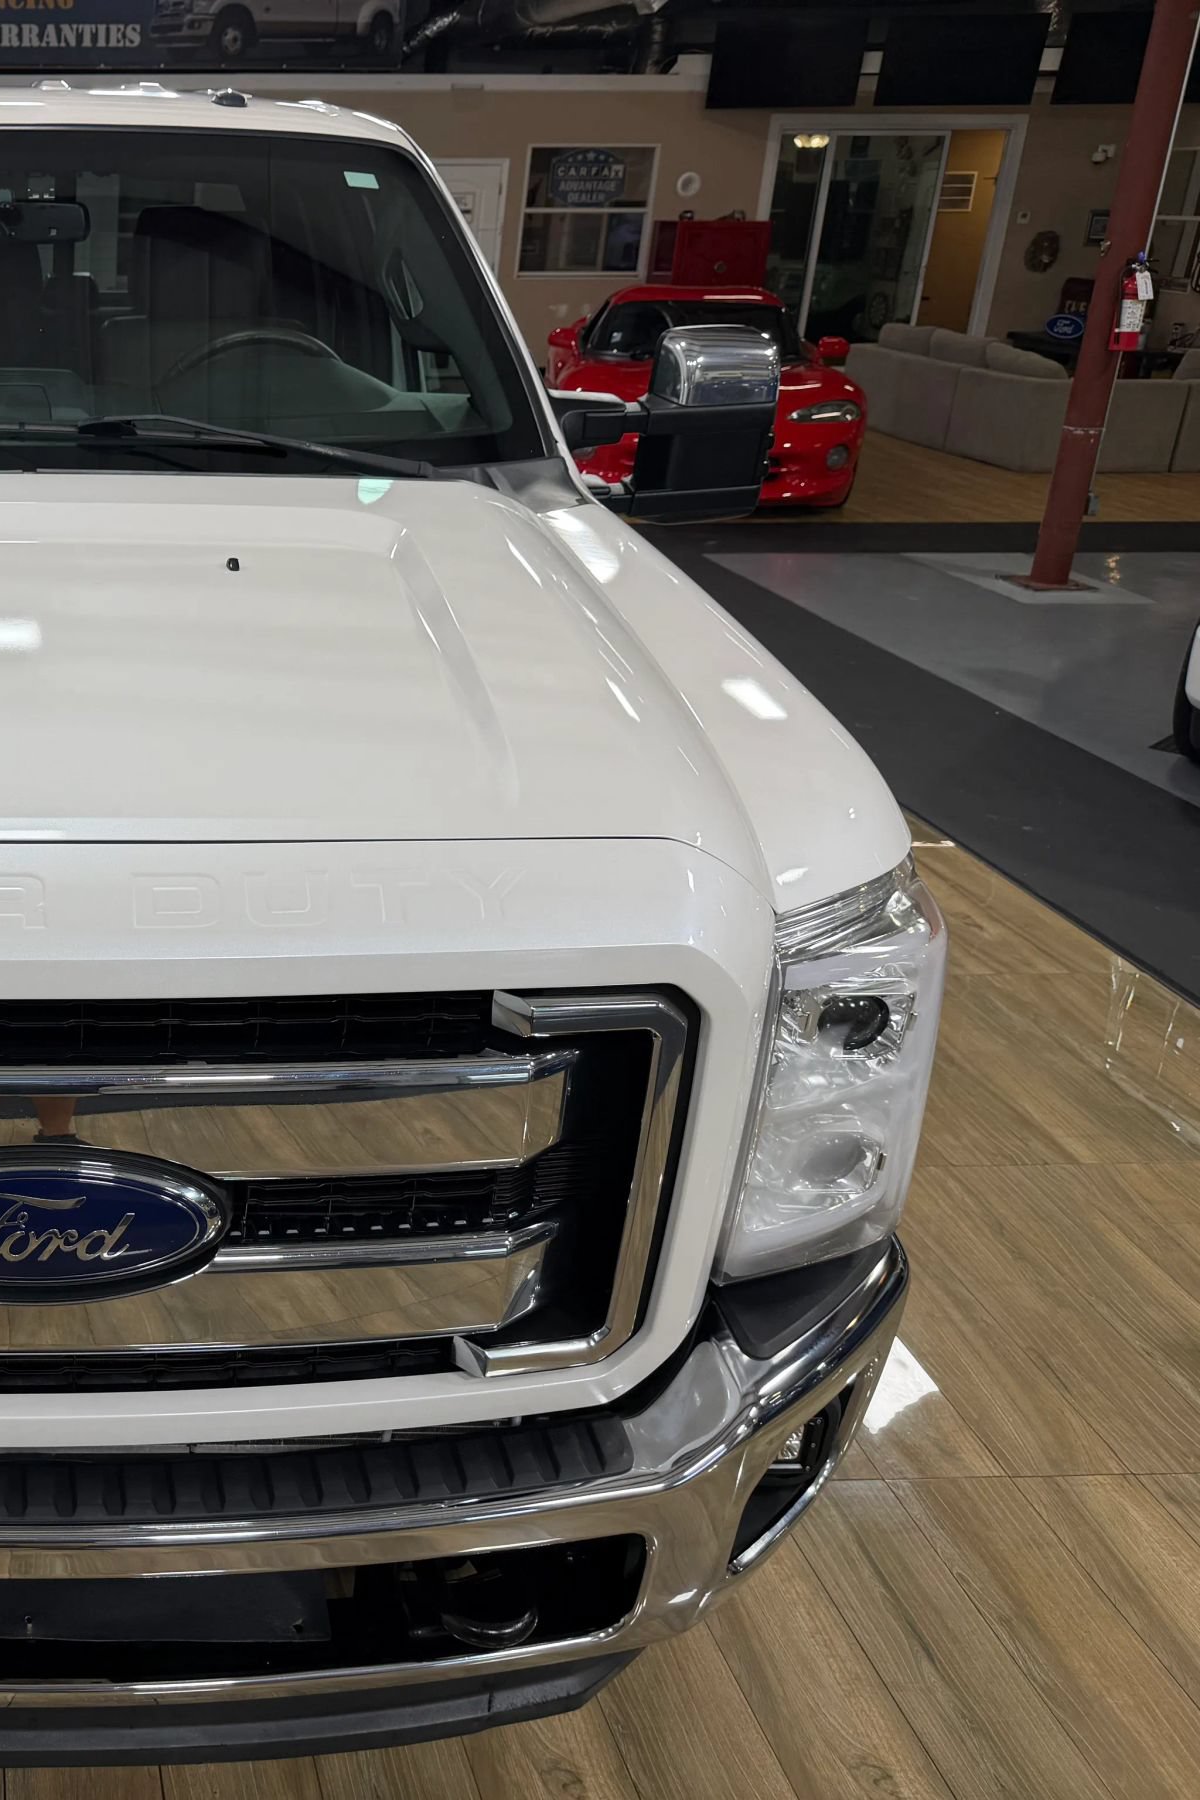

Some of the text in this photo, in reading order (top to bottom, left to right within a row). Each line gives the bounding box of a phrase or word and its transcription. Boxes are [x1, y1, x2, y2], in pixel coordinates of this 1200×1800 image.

[557, 165, 623, 178] CARFAX
[559, 180, 617, 192] ADVANTAGE
[567, 192, 606, 203] DEALER
[131, 868, 526, 928] DUTY
